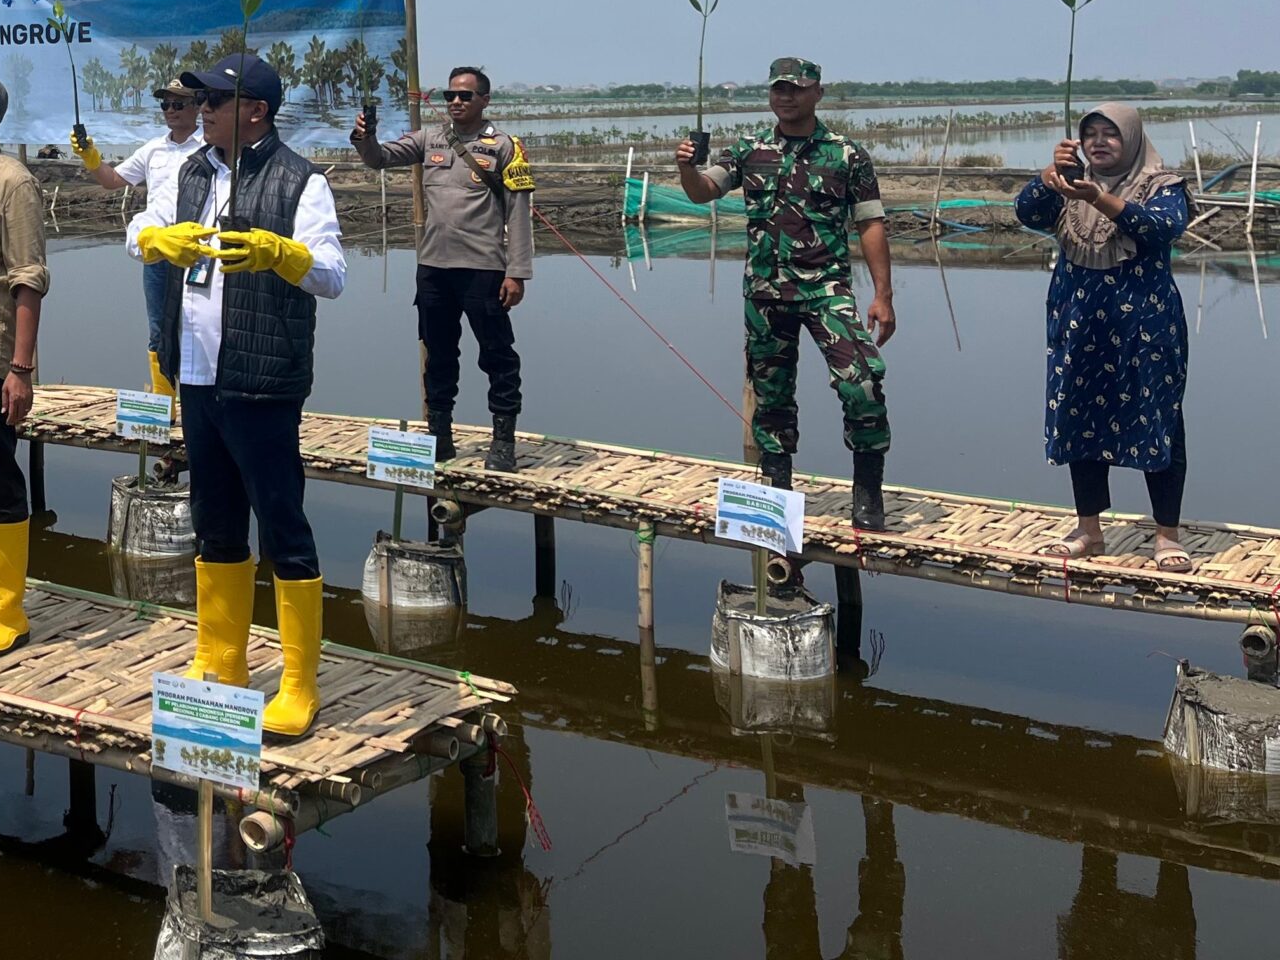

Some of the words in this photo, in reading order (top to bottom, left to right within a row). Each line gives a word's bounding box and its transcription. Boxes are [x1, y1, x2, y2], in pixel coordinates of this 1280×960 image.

[746, 500, 774, 511] BABINSA
[157, 690, 186, 703] PROGRAM
[186, 695, 224, 709] PENANAMAN
[224, 703, 258, 716] MANGROVE
[198, 706, 224, 717] INDONESIA
